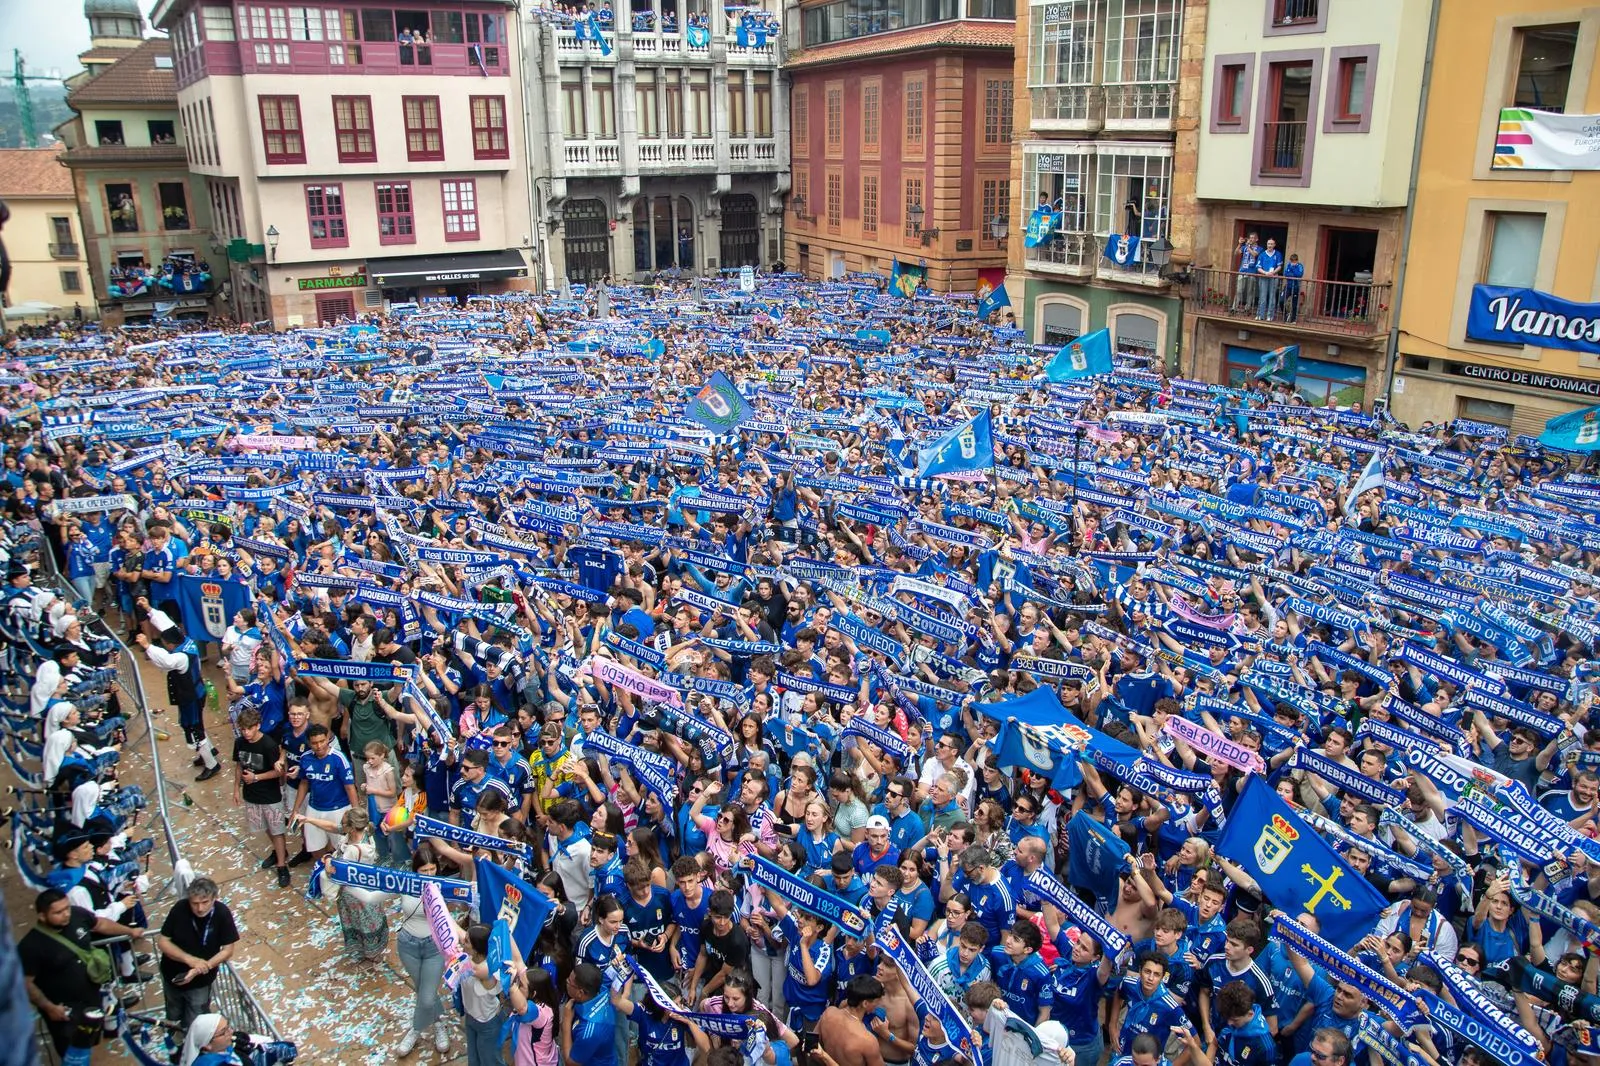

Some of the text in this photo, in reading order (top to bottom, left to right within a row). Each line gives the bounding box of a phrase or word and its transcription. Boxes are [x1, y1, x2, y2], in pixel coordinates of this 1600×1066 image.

[300, 276, 365, 290] FARMACIA
[1488, 297, 1600, 342] Vamos
[1464, 366, 1510, 380] CENTRO
[1512, 374, 1528, 384] DE
[346, 382, 371, 390] OVIEDO
[756, 422, 784, 431] OVIEDO
[247, 436, 296, 444] Real OVIEDO
[1297, 432, 1323, 443] OVIEDO
[506, 462, 524, 471] Real
[1420, 456, 1445, 468] OVIEDO
[525, 479, 574, 493] Real OVIEDO
[568, 475, 605, 485] Real OVIEDO
[244, 490, 260, 498] Real
[262, 488, 285, 497] OVIEDO
[1075, 490, 1134, 508] INQUEBRANTABLES
[1264, 491, 1315, 512] Real OVIEDO
[451, 502, 471, 510] OVIEDO
[524, 499, 577, 522] Real OVIEDO
[1202, 498, 1218, 510] Real
[1389, 505, 1401, 514] NO
[469, 518, 485, 529] Real
[518, 516, 528, 524] R.
[840, 505, 855, 516] Real
[856, 510, 880, 524] OVIEDO
[955, 504, 1008, 527] Real OVIEDO
[1022, 502, 1068, 531] Real OVIEDO
[1134, 517, 1167, 532] OVIEDO
[1462, 518, 1510, 533] Real OVIEDO
[937, 528, 970, 543] OVIEDO
[424, 550, 492, 562] Real OVIEDO 1926
[585, 560, 606, 569] DIGI
[689, 553, 744, 572] Real OVIEDO 1926
[526, 576, 599, 601] Siempre Contigo
[917, 602, 976, 635] Real OVIEDO
[1291, 598, 1359, 629] Real OVIEDO
[1481, 601, 1542, 638] REAL OVIEDO
[839, 616, 894, 655] Real OVIEDO
[1176, 625, 1227, 644] REAL OVIEDO
[1484, 628, 1500, 642] OF
[1505, 637, 1524, 658] YOU
[620, 639, 660, 663] Real OVIEDO
[978, 652, 998, 665] DIGI
[311, 663, 392, 677] Real OVIEDO 1926
[601, 663, 644, 690] OVIEDO
[1038, 662, 1068, 676] OVIEDO
[1070, 662, 1090, 678] Real
[1405, 646, 1501, 696] INQUEBRANTABLES
[695, 676, 746, 702] OVIEDO
[780, 676, 855, 702] INQUEBRANTABLE
[1465, 691, 1561, 734] INQUEBRANTABLES
[1171, 716, 1250, 765] Real OVIEDO
[306, 772, 334, 782] DIGI
[1093, 748, 1159, 796] Real OVIEDO
[1409, 749, 1467, 792] OVIEDO
[1301, 753, 1400, 808] INQUEBRANTABLES
[1509, 785, 1533, 813] Real
[417, 819, 448, 839] Real
[347, 867, 443, 898] Real OVIEO
[755, 864, 841, 918] Real OVIEDO 1926
[1031, 869, 1126, 951] INQUEBRANTABLES
[432, 903, 455, 948] OVIEDO
[1276, 924, 1321, 958] ORGULLO
[1321, 952, 1356, 979] VALOR
[1358, 972, 1367, 986] Y
[896, 947, 912, 979] Real
[910, 969, 942, 1017] OVIEDO
[1433, 999, 1524, 1066] Real OVIEDO
